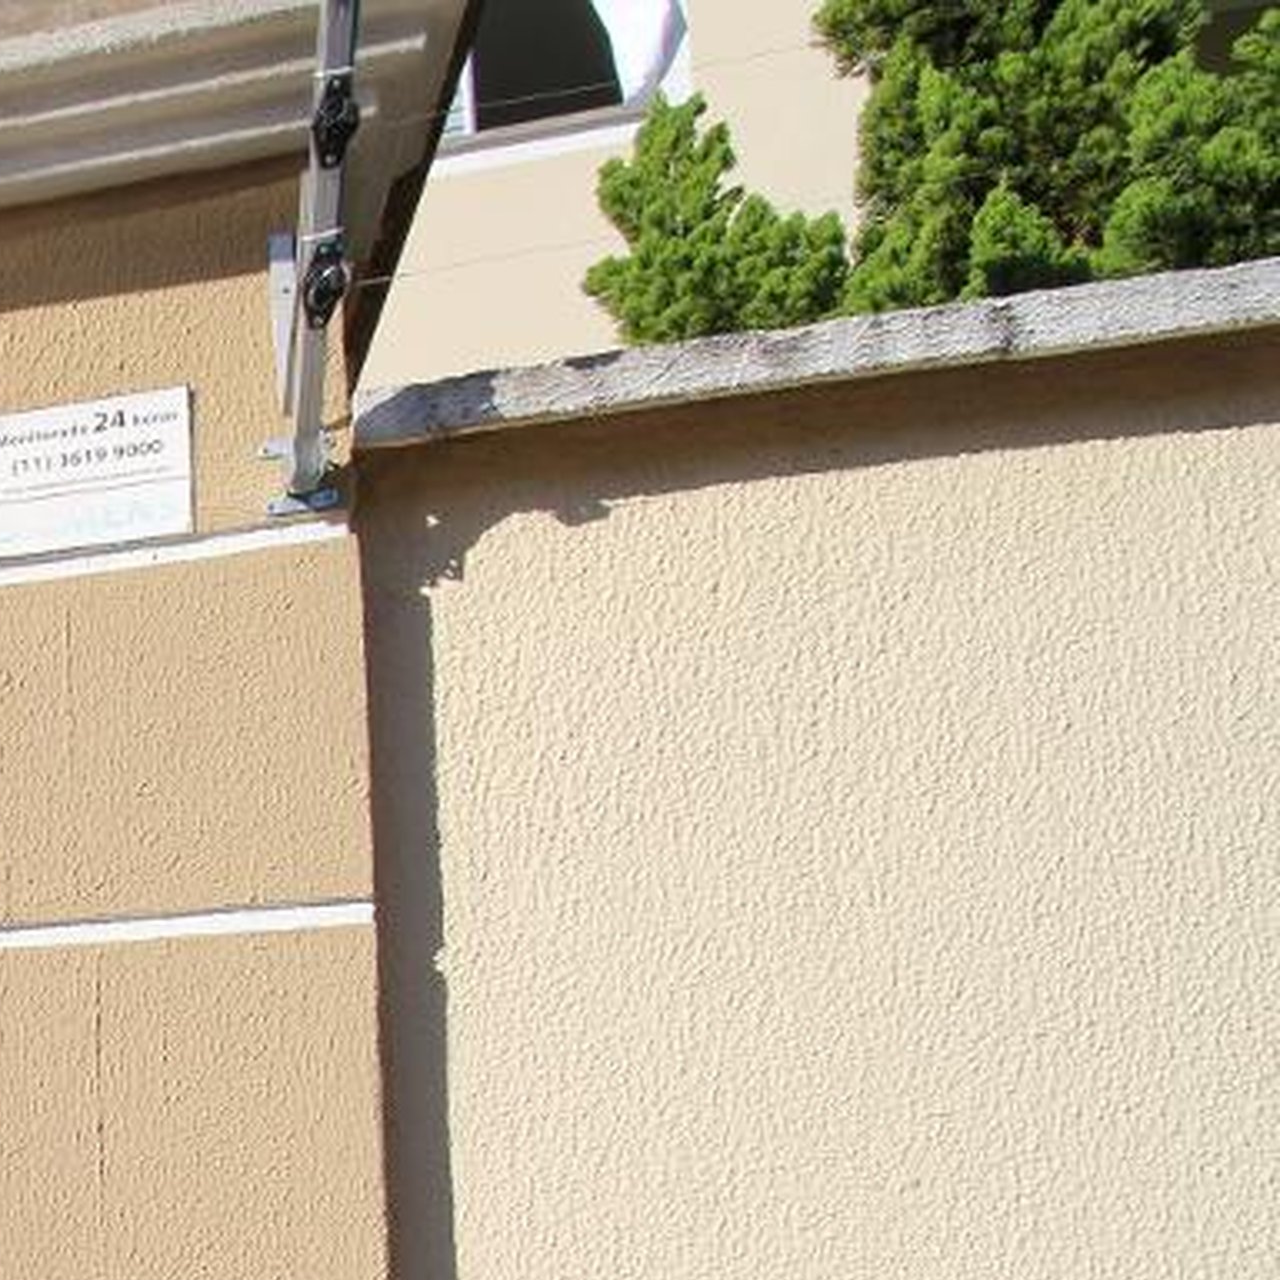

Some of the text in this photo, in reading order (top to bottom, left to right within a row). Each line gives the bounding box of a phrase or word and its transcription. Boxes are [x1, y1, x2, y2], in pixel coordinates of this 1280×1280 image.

[92, 409, 127, 434] 24
[11, 455, 53, 477] (11)
[112, 438, 165, 461] 9000
